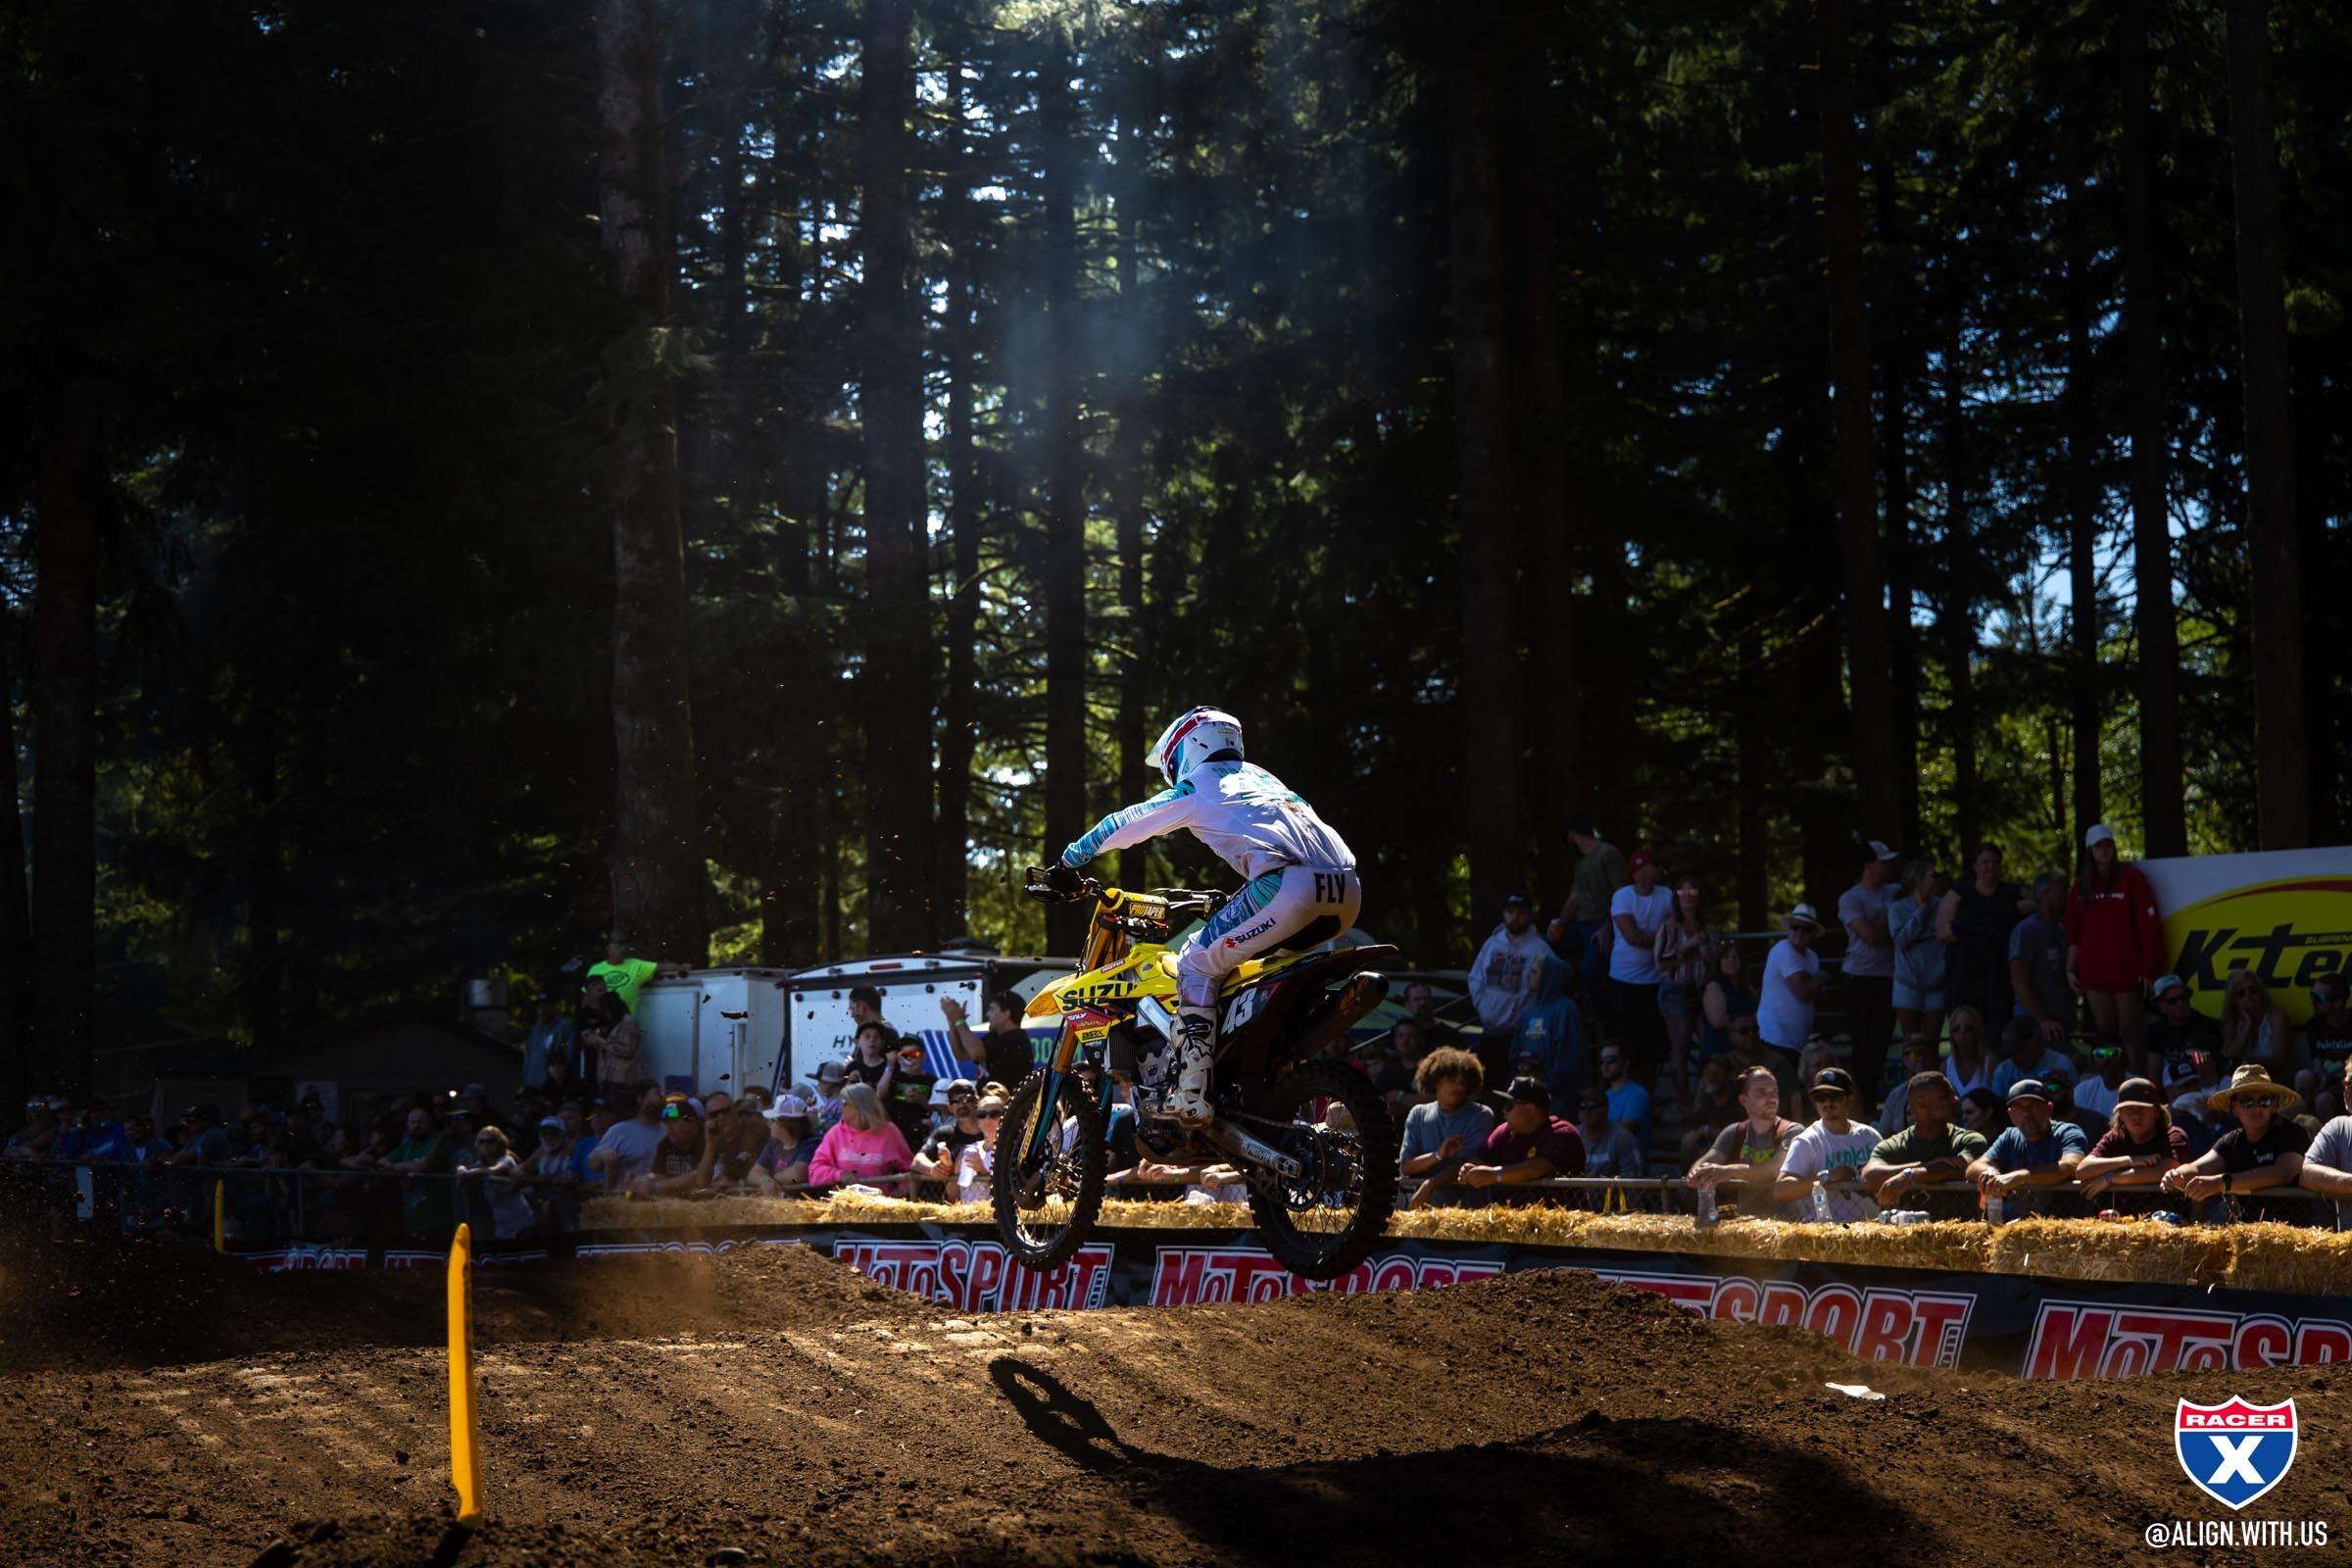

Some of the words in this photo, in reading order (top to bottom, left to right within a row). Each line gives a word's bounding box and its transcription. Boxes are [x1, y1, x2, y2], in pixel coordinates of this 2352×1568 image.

[1314, 872, 1346, 905] FLY
[1131, 904, 1164, 919] PROTAPER
[1235, 917, 1277, 944] SUZUKI
[1102, 959, 1124, 972] MOTUL
[2173, 923, 2352, 991] K-te
[1062, 983, 1137, 1010] SUZU
[1220, 988, 1258, 1036] 43
[1598, 1269, 1977, 1371] SPORT
